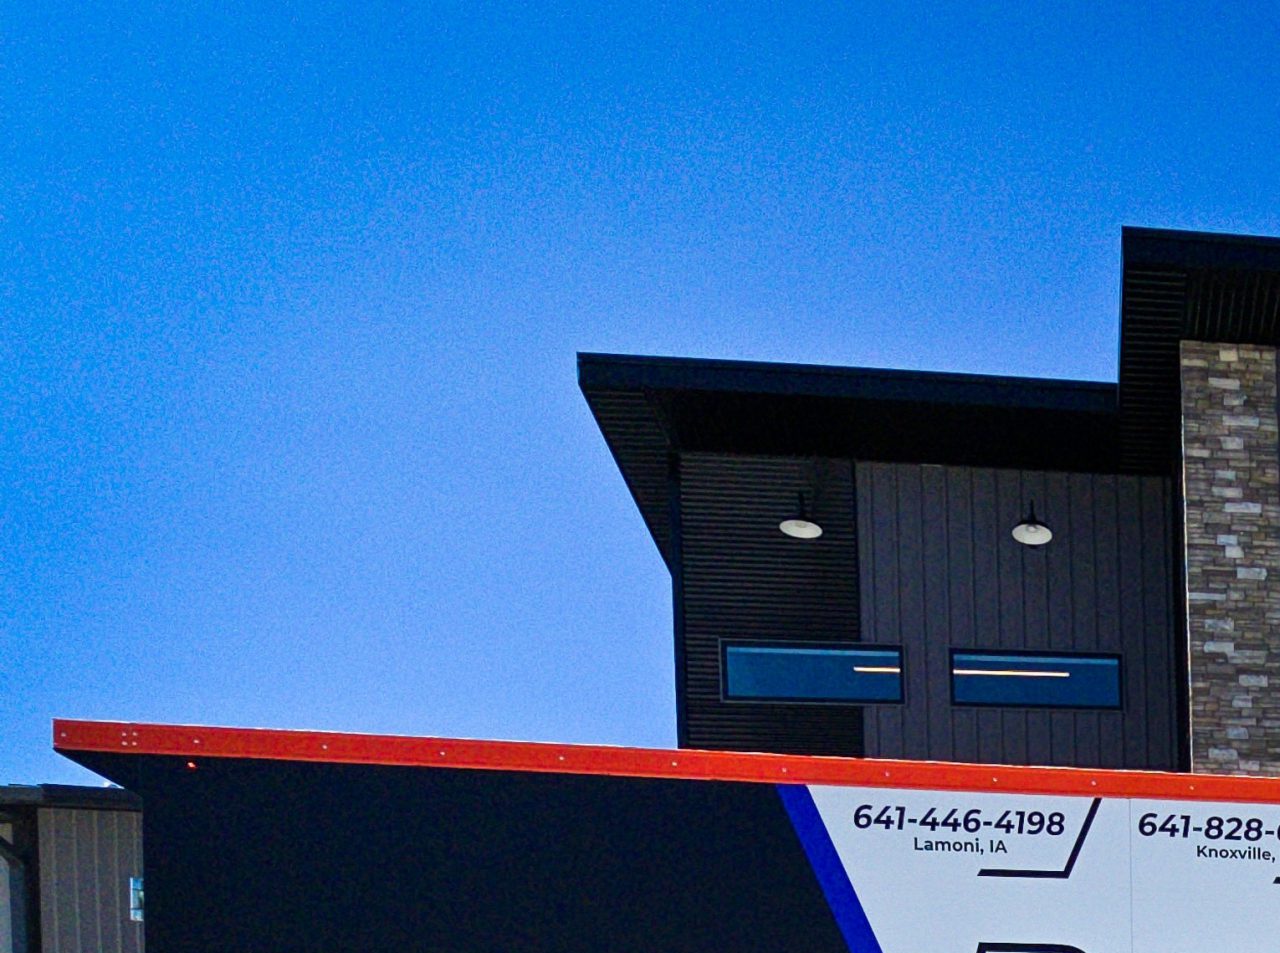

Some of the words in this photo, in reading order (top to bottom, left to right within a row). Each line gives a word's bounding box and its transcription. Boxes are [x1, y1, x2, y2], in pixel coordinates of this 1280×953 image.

[853, 804, 1066, 836] 641-446-4198
[913, 837, 985, 855] Lamoni,
[989, 840, 1008, 854] IA
[1196, 845, 1276, 863] Knoxville,
